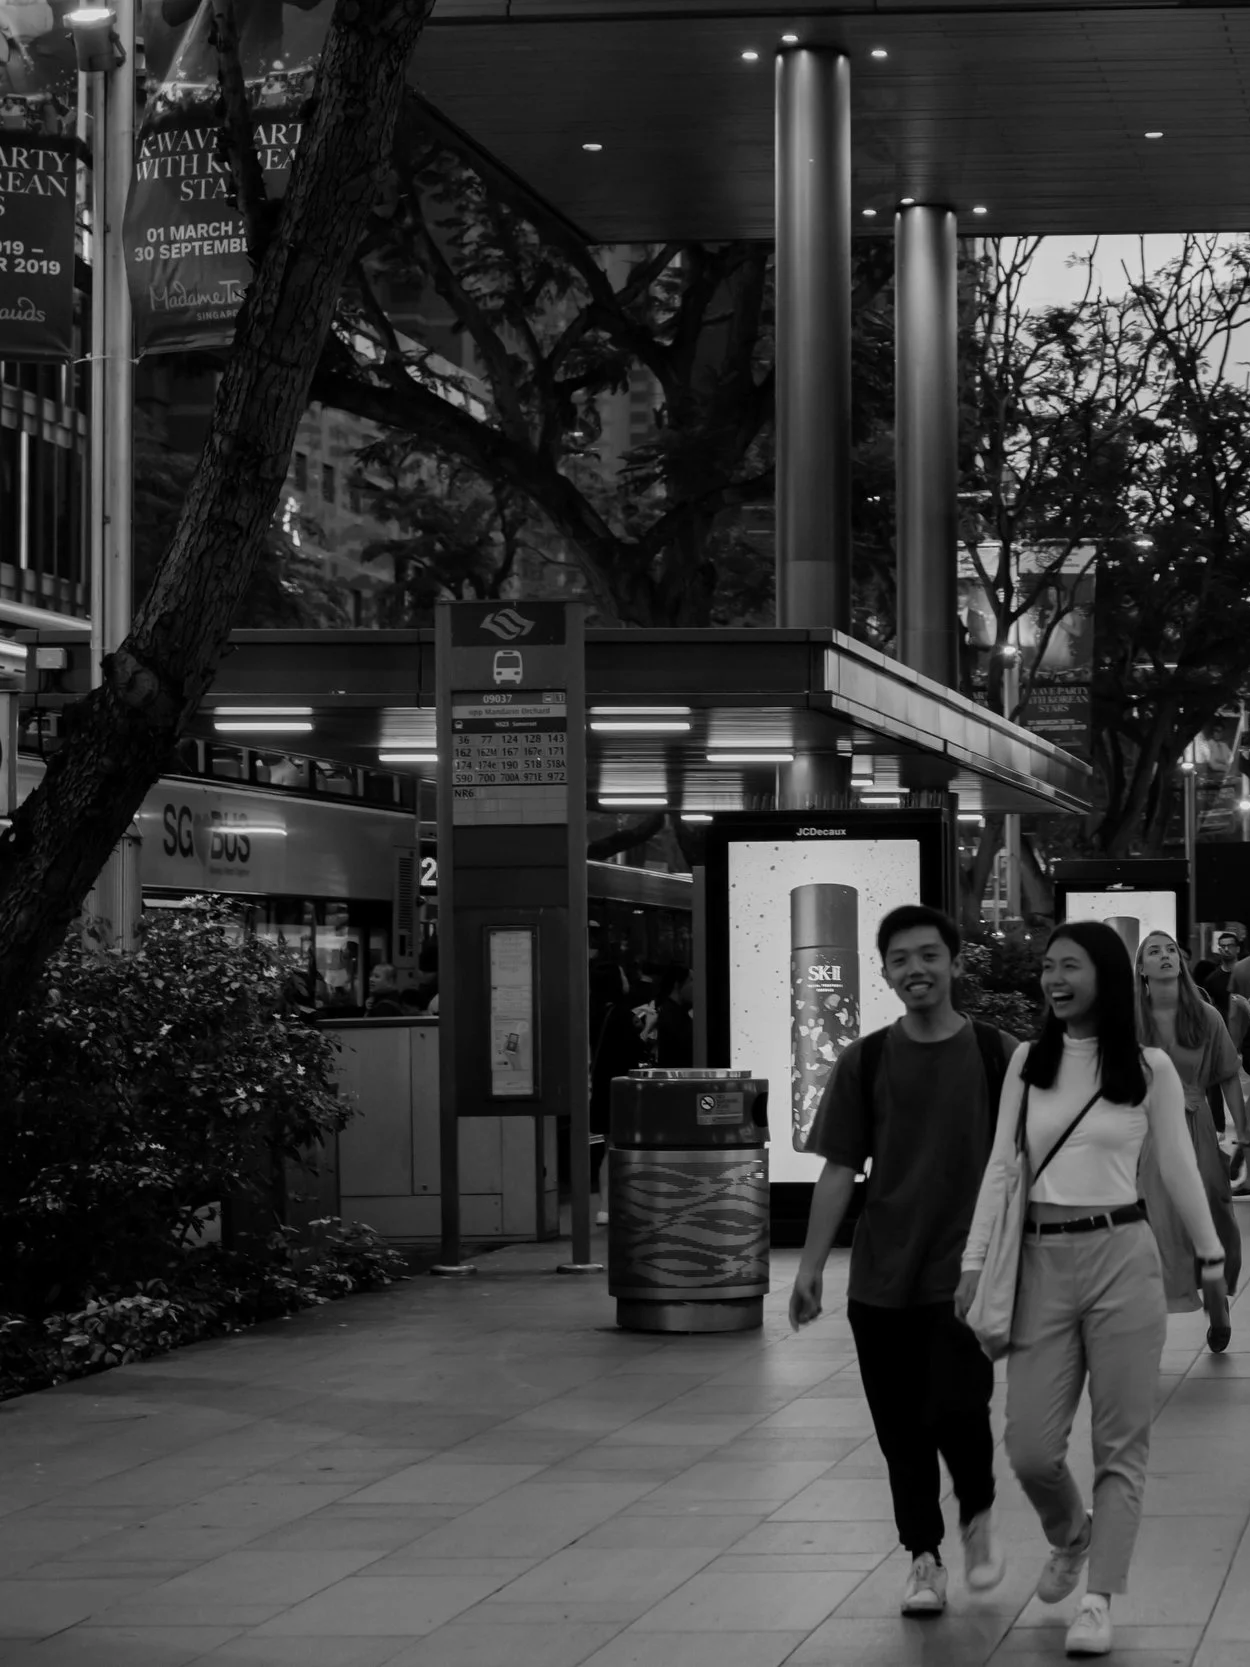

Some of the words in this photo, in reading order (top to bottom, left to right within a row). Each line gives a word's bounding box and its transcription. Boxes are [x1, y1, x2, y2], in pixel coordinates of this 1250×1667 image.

[253, 123, 303, 146] ART
[136, 153, 199, 182] WITH
[0, 171, 69, 198] EAN
[180, 177, 229, 201] STA
[147, 227, 165, 243] 01
[170, 220, 233, 241] MARCH
[0, 240, 24, 255] 19
[134, 245, 155, 262] 30
[160, 236, 249, 260] SEPTEMBE
[14, 258, 61, 275] 2019
[149, 280, 224, 311] Madame
[482, 694, 512, 704] 09037
[458, 735, 470, 744] 36
[481, 735, 493, 744] 77
[502, 735, 518, 743] 124
[525, 734, 541, 743] 128
[548, 734, 564, 742] 143
[455, 748, 472, 757] 162
[477, 748, 497, 757] 162M
[502, 748, 519, 756] 167
[548, 747, 564, 755] 171
[456, 761, 472, 770] 174
[502, 761, 518, 769] 190
[524, 760, 542, 768] 518
[547, 760, 566, 768] 518A
[455, 774, 473, 783] 590
[478, 774, 495, 782] 700
[501, 773, 519, 782] 700A
[524, 773, 542, 781] 971E
[547, 772, 565, 781] 972
[454, 789, 474, 798] NR6
[163, 803, 193, 858] SG
[211, 810, 250, 863] BUS
[795, 827, 847, 836] JCDecaux
[421, 857, 438, 886] 2
